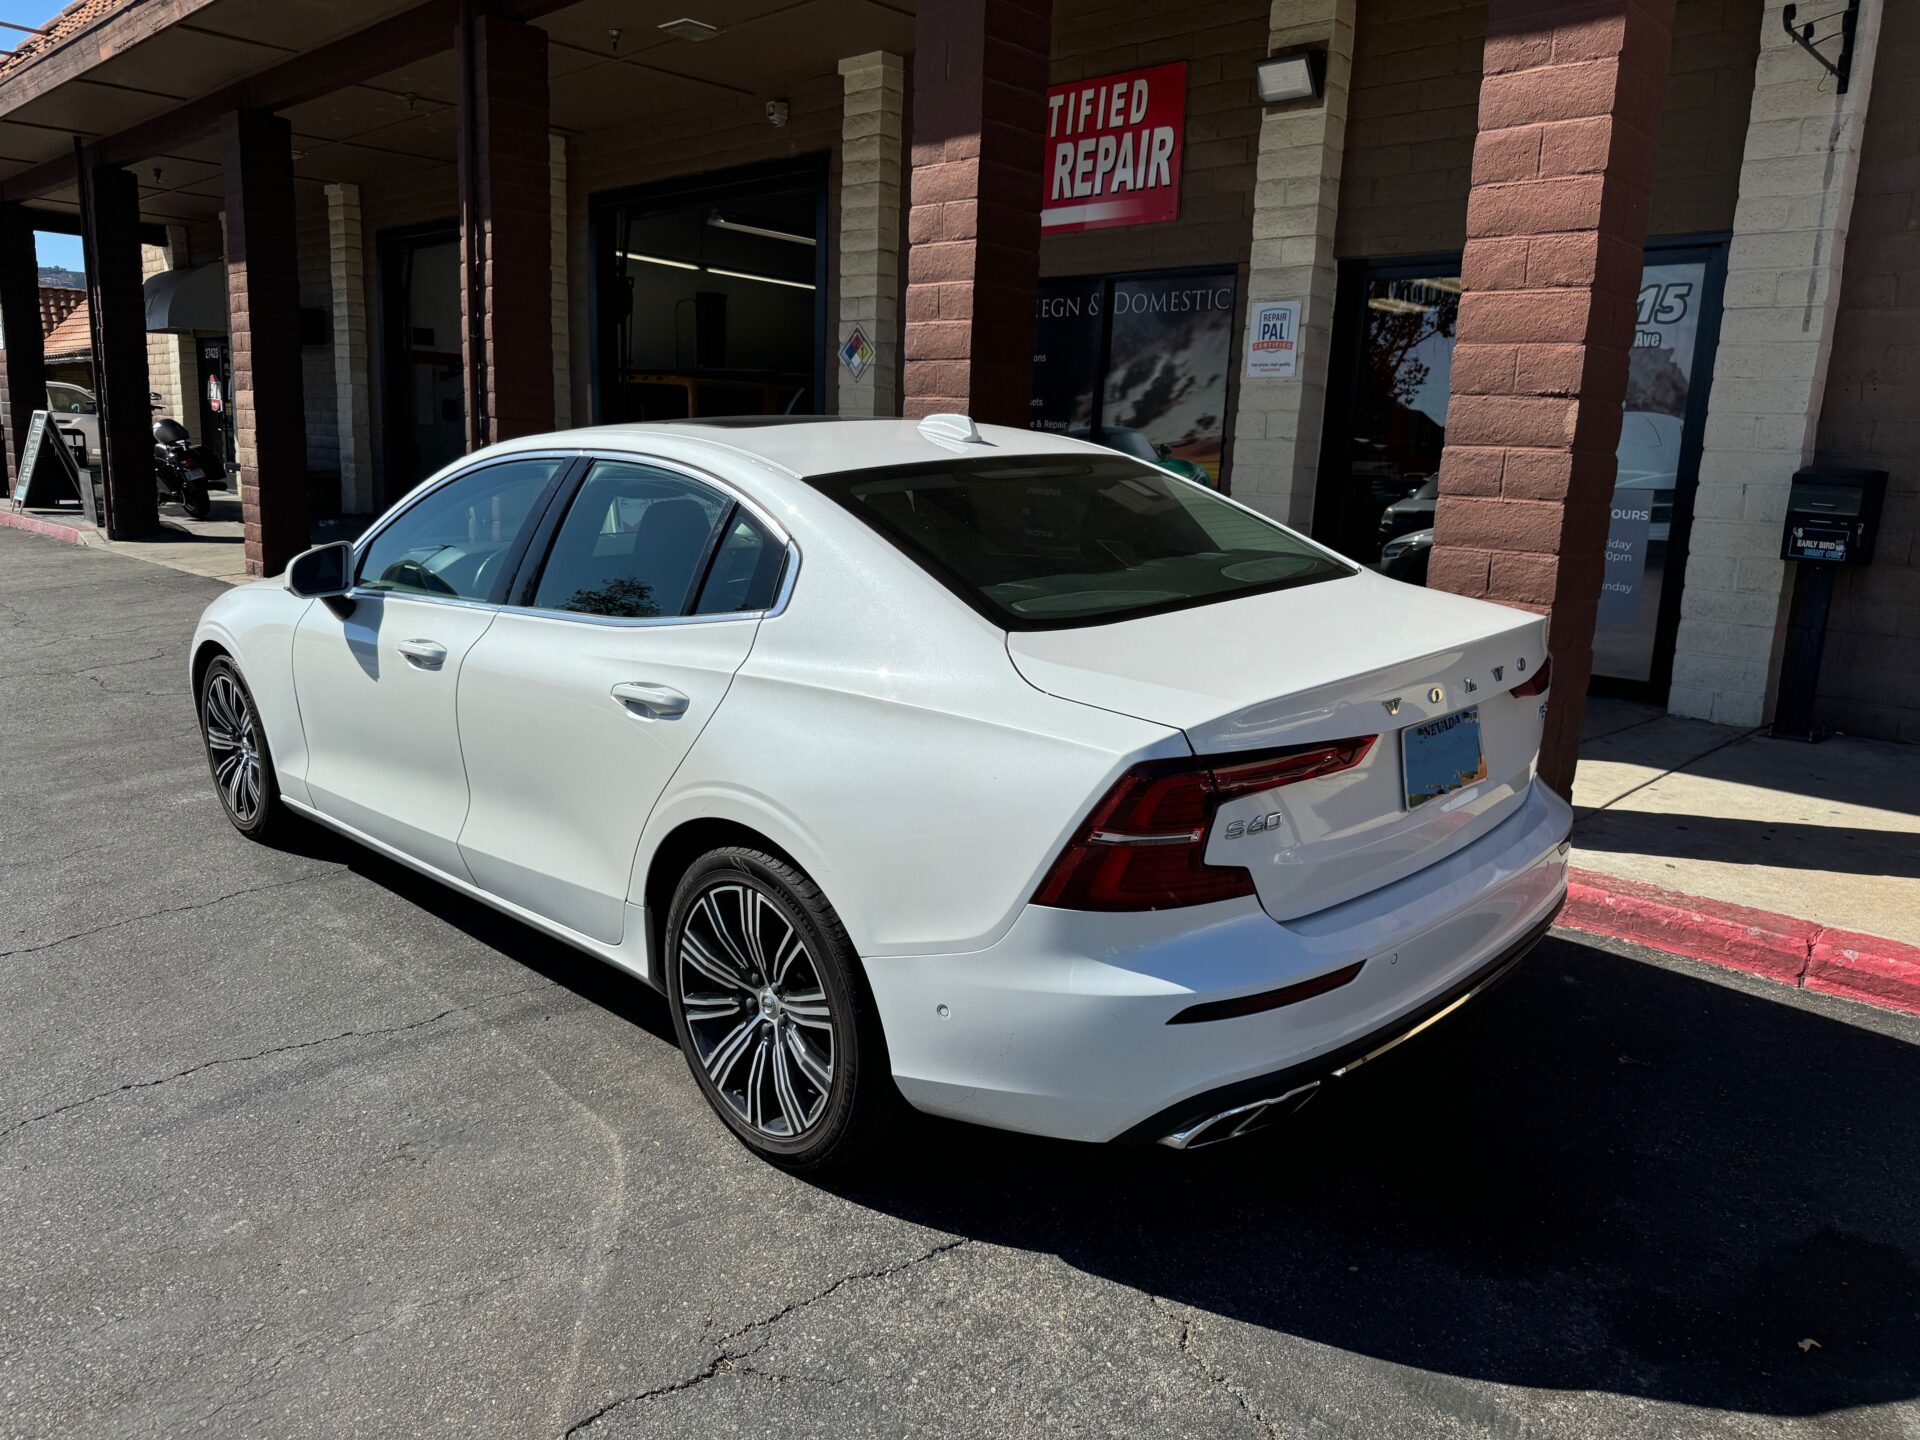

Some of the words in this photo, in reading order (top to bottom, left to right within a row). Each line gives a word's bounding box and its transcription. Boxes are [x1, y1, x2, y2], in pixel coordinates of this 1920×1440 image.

[1048, 79, 1149, 138] TIFIED
[1051, 126, 1175, 200] REPAIR
[1036, 297, 1081, 319] EGN
[1088, 292, 1100, 316] &
[1114, 288, 1231, 315] DOMESTIC
[1263, 312, 1287, 322] REPAIR
[1262, 323, 1285, 340] PAL
[1633, 330, 1662, 348] Ave
[1044, 420, 1068, 430] Repair
[1611, 509, 1649, 520] OURS
[1797, 539, 1818, 548] EARLY
[1819, 541, 1836, 550] BIRD
[1382, 657, 1526, 716] VOLVO
[1422, 714, 1461, 738] NEVADA
[1225, 812, 1283, 840] S60
